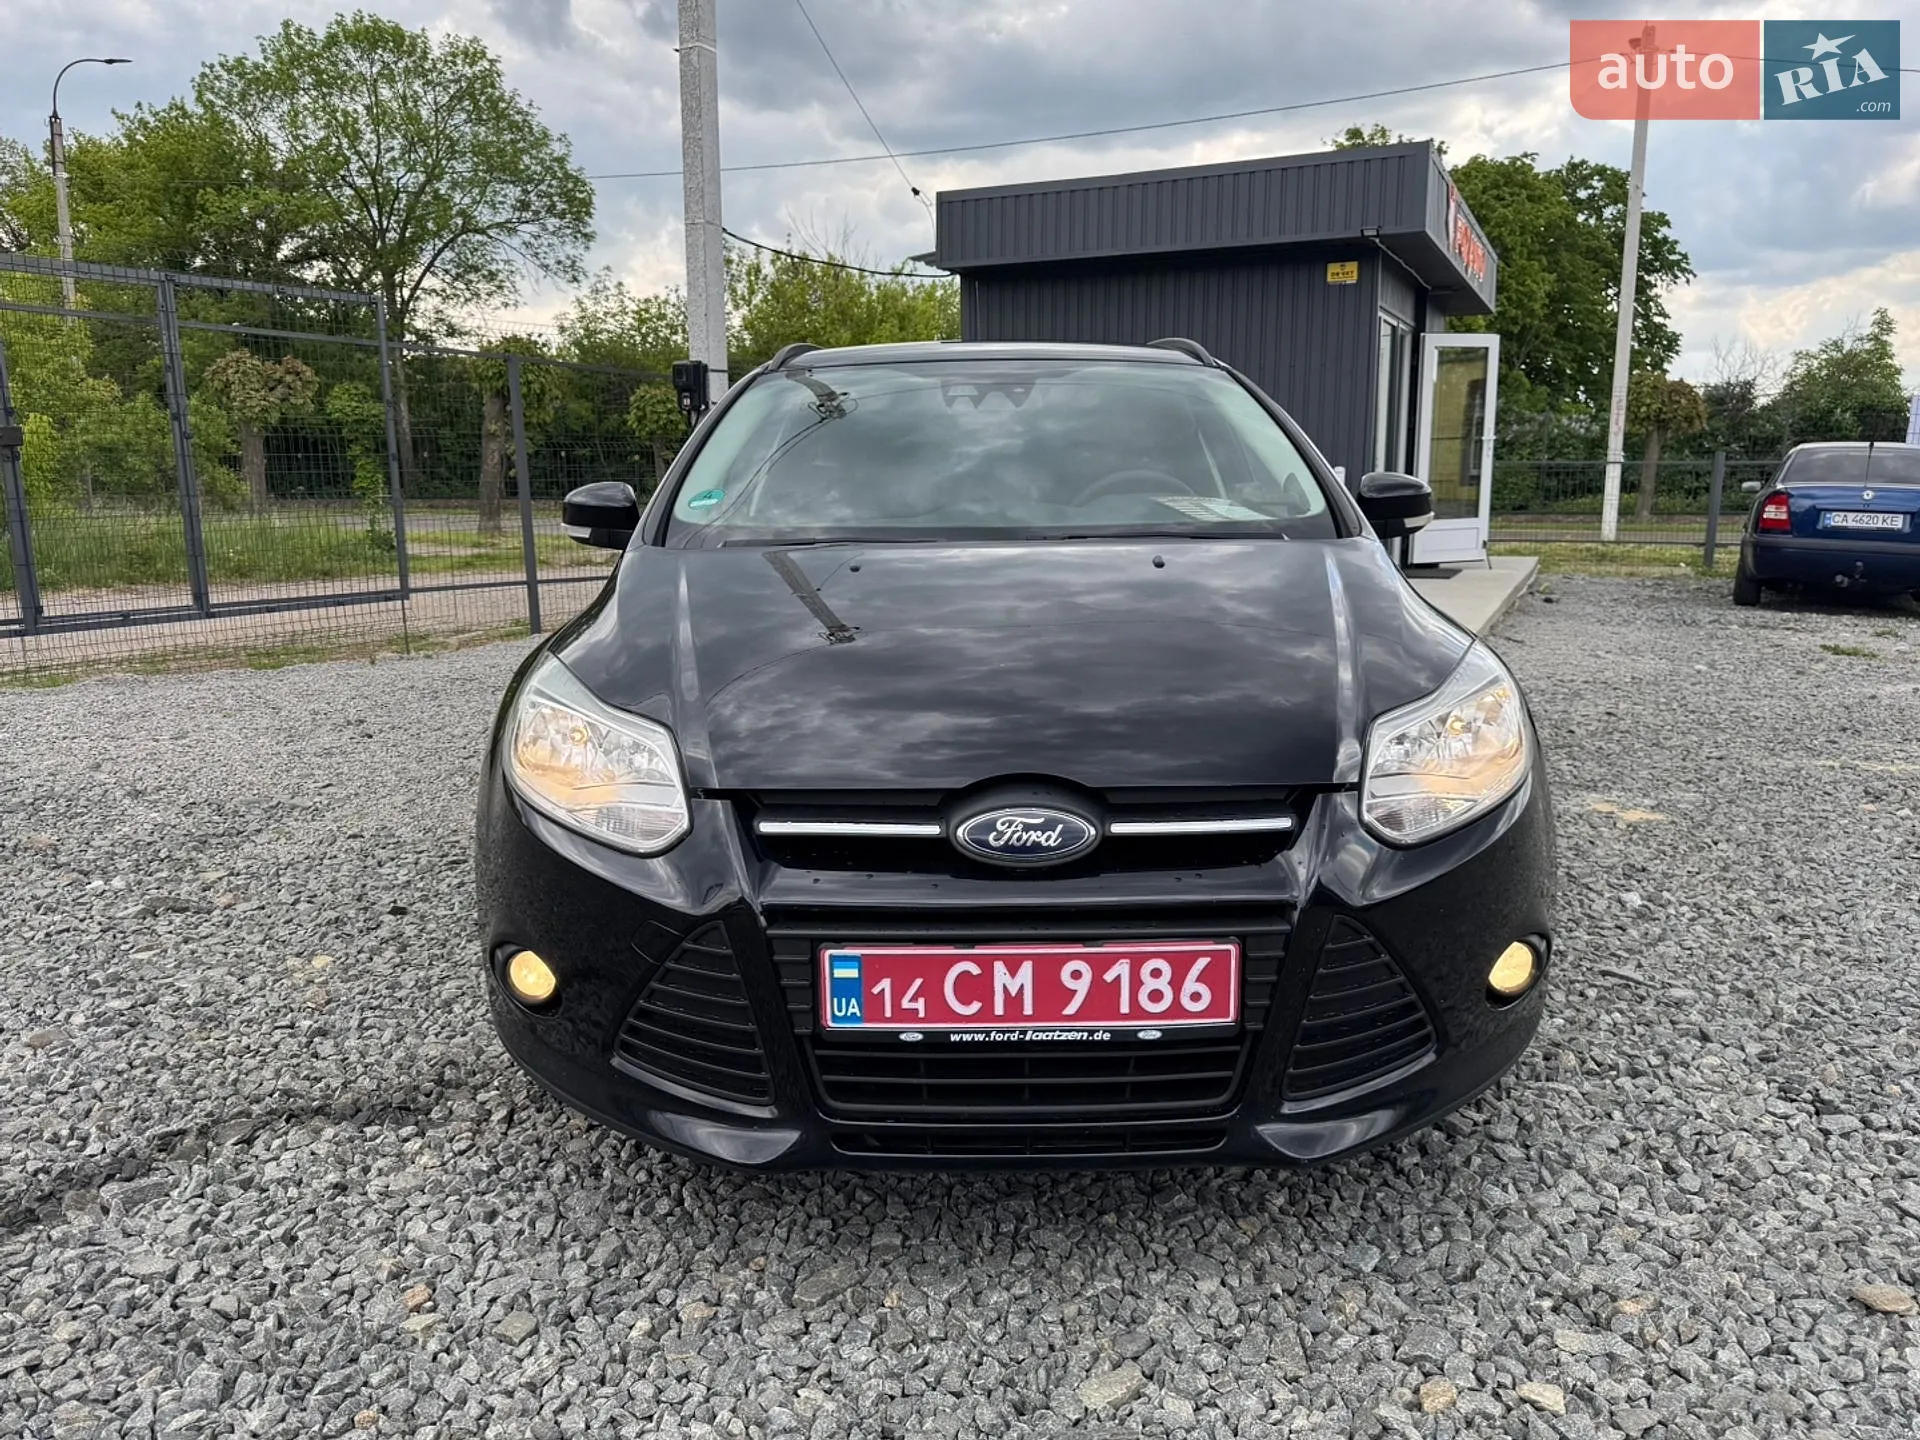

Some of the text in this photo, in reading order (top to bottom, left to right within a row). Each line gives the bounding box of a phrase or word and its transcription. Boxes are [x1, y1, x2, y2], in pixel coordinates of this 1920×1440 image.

[1832, 513, 1848, 524] CA
[1852, 514, 1879, 525] 4620
[1881, 515, 1900, 527] KE
[988, 816, 1064, 847] Ford
[871, 957, 1212, 1018] 14 CM 9186
[833, 997, 861, 1017] UA
[950, 1030, 1111, 1041] www.ford-laatzen.de
